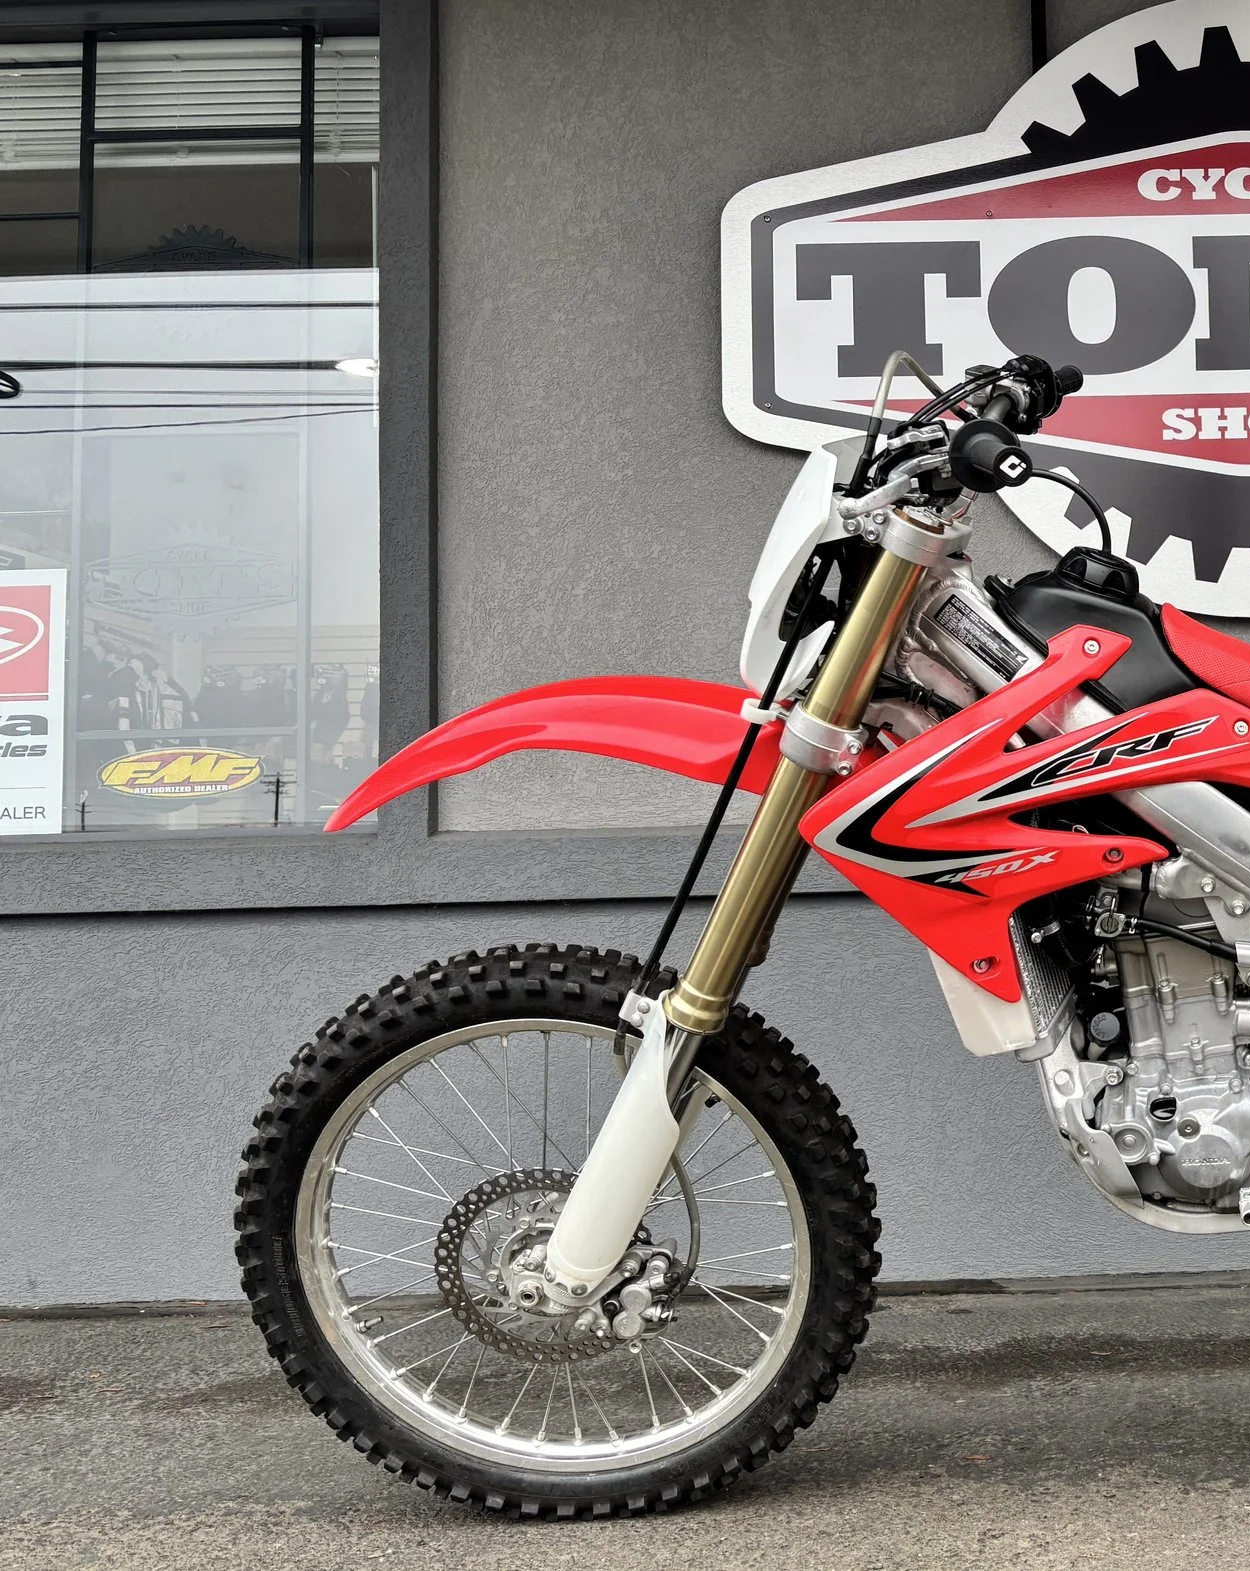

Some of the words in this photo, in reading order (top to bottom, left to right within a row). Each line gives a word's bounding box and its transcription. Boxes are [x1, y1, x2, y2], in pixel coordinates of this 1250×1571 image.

[1031, 715, 1220, 787] CRF
[103, 753, 262, 786] FMF
[133, 785, 192, 795] AUTHORIZED
[194, 784, 230, 793] DEALER
[934, 849, 1060, 884] 450X
[1181, 1157, 1231, 1167] HONDA
